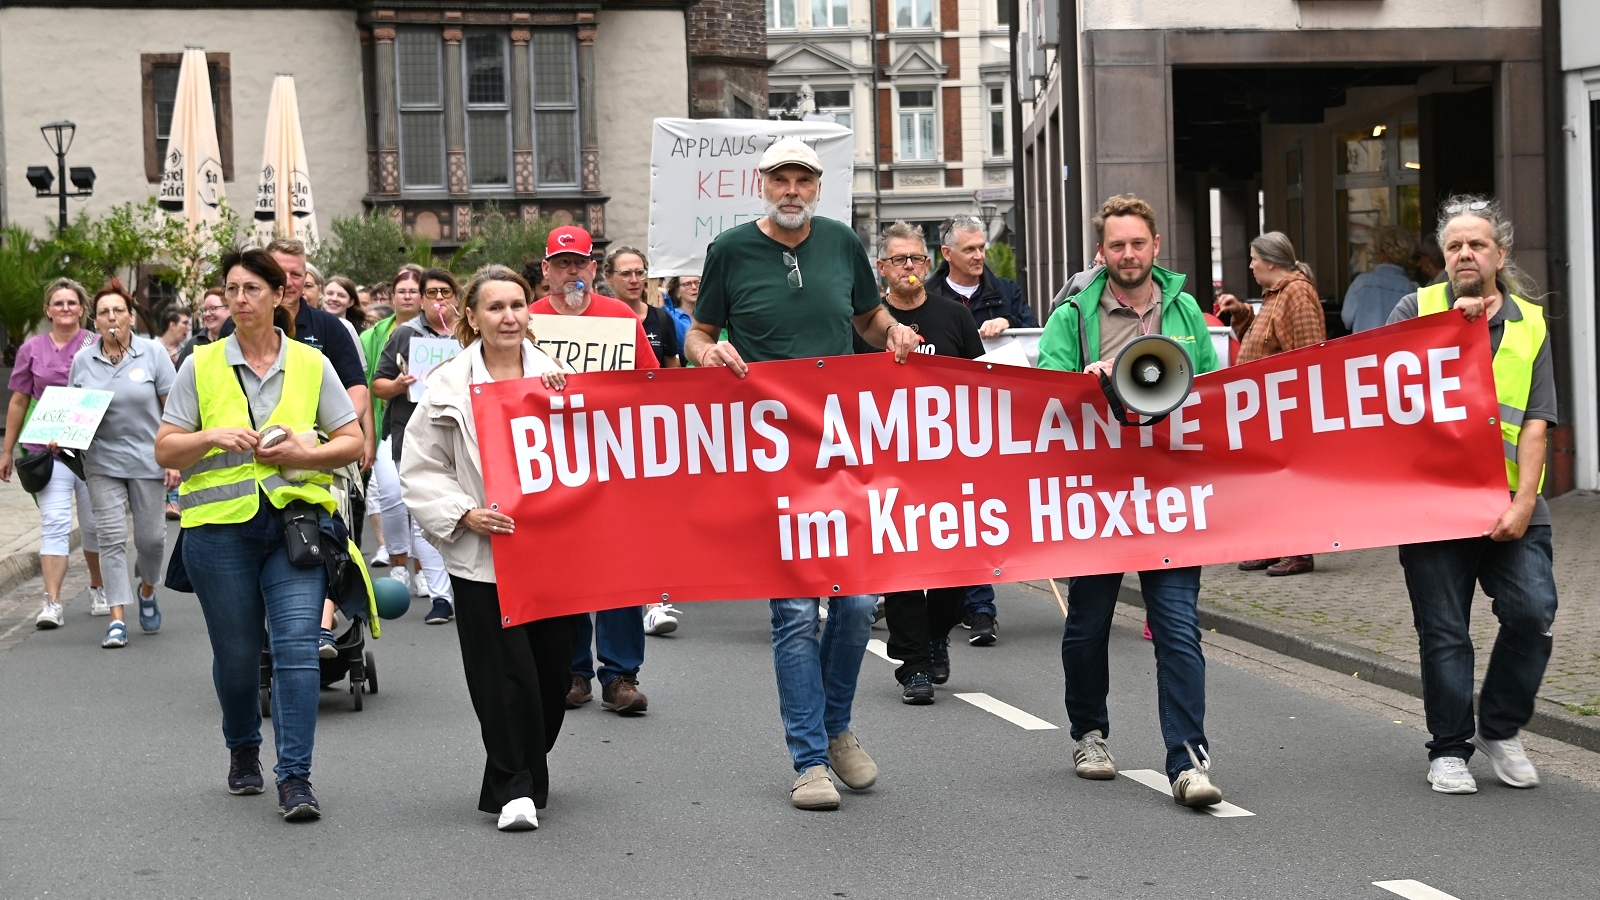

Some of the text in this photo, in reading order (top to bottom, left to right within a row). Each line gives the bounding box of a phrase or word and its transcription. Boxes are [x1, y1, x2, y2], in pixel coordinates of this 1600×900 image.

[671, 135, 757, 158] APPLAUS
[510, 394, 790, 496] BÜNDNIS
[1223, 346, 1467, 451] PFLEGE
[778, 475, 1214, 561] im Kreis Höxter
